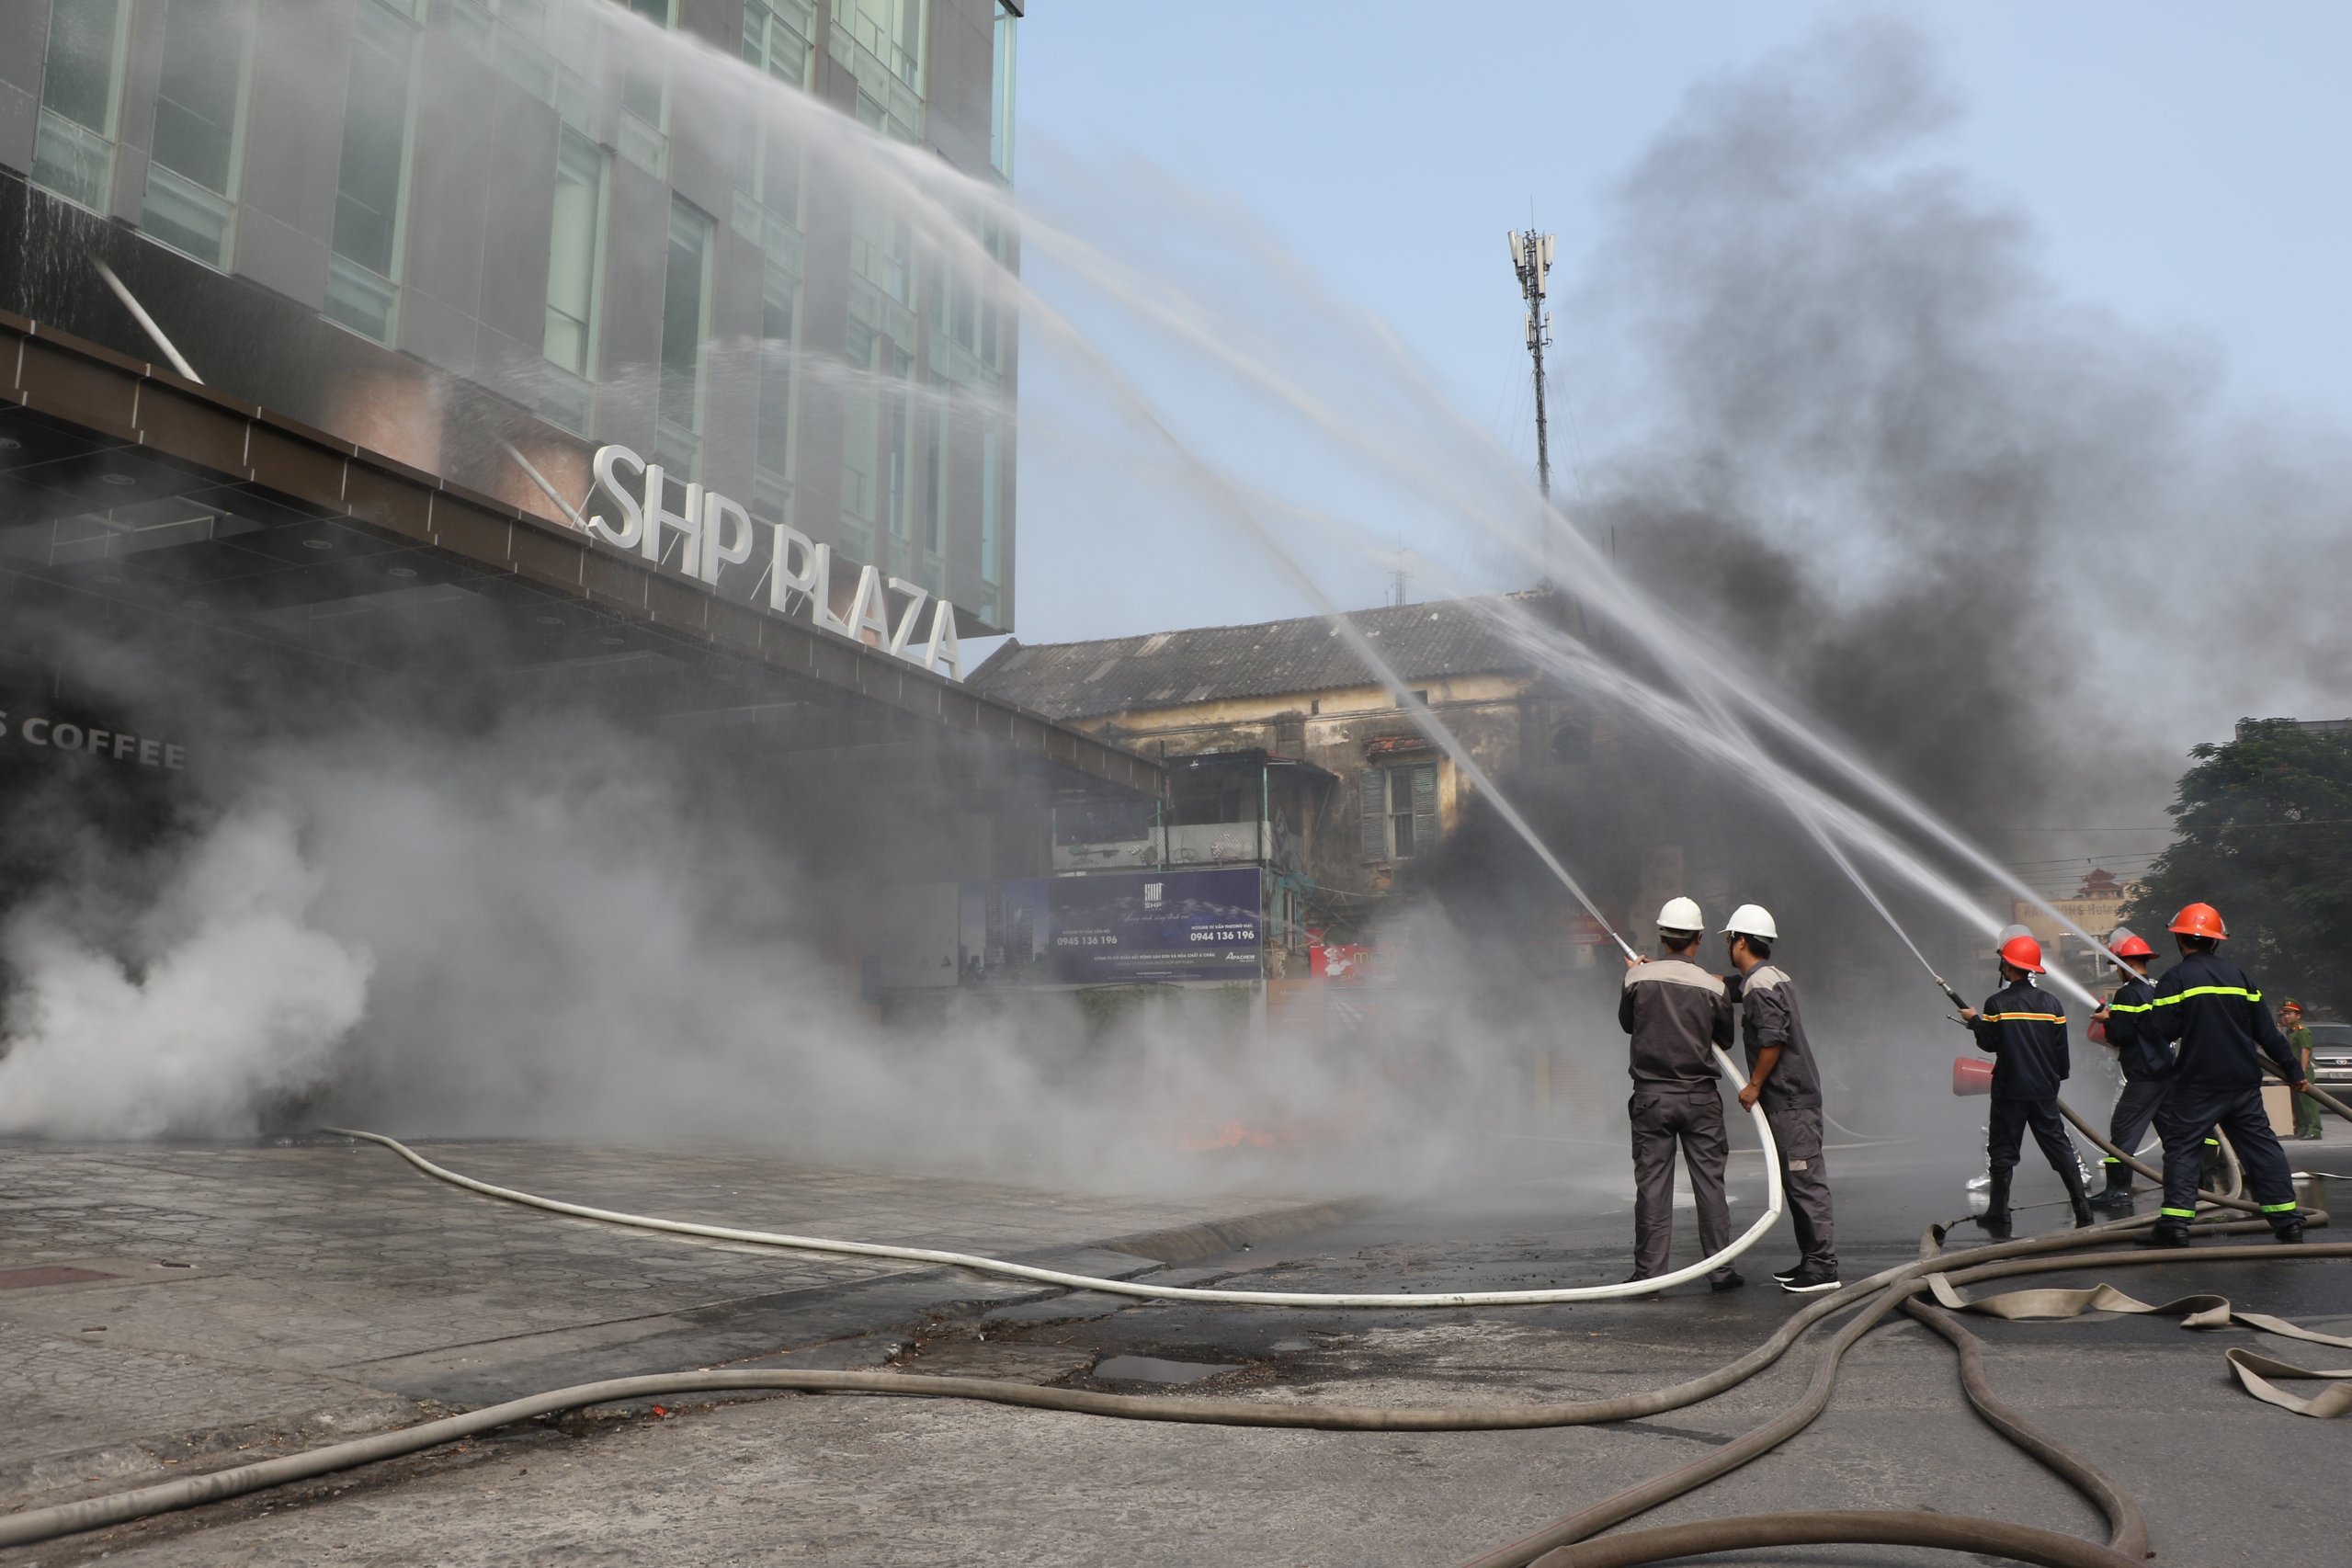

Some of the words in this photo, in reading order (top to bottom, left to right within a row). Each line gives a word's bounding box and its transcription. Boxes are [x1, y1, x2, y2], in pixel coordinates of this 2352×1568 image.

[588, 444, 753, 586] SHP
[770, 523, 963, 683] PLAZA
[22, 717, 186, 771] COFFEE
[1057, 937, 1079, 946] 0945
[1082, 937, 1098, 945] 136
[1101, 936, 1118, 945] 196
[1190, 932, 1214, 941] 0944
[1216, 931, 1233, 940] 136
[1236, 930, 1255, 940] 196
[1225, 952, 1256, 960] APACHEM
